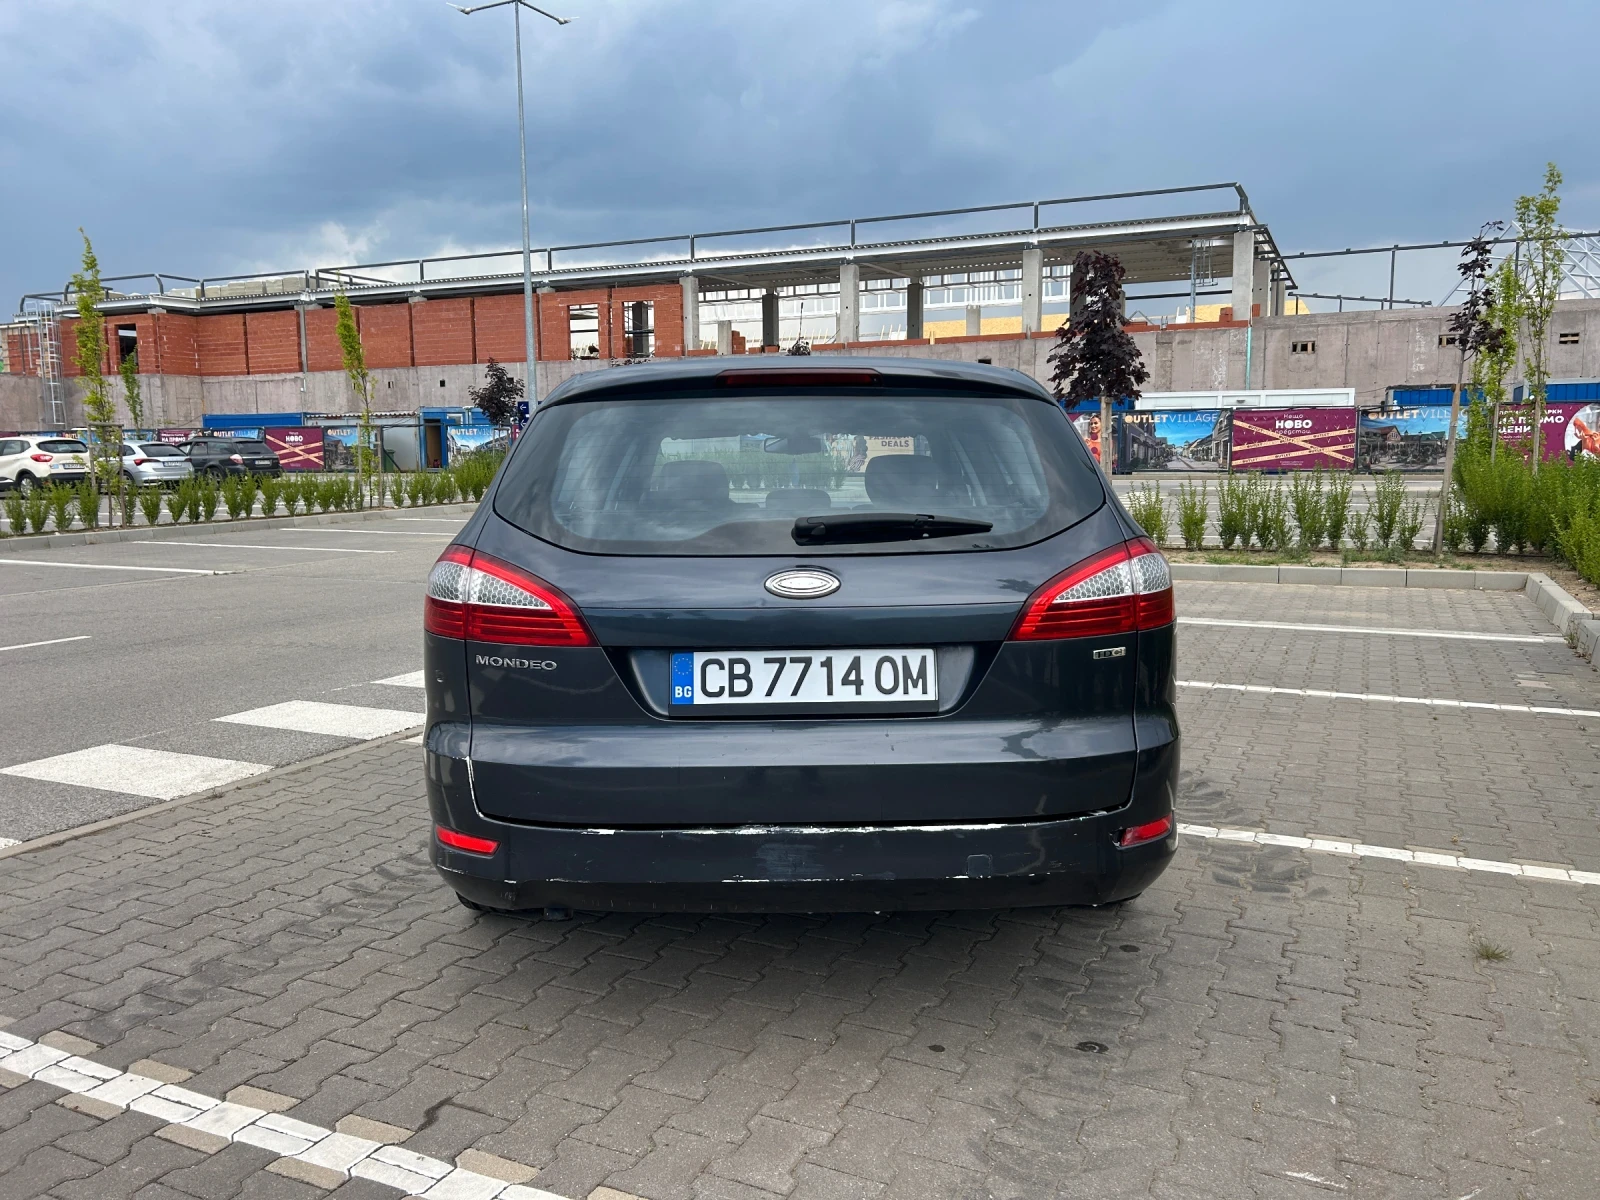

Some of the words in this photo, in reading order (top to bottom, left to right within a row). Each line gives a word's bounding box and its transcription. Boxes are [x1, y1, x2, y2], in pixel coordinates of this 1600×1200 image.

[1275, 419, 1312, 429] НОВО
[475, 655, 558, 671] MONDEO
[700, 657, 754, 698] CB
[763, 655, 864, 697] 7714
[874, 655, 928, 696] OM
[674, 686, 692, 698] BG
